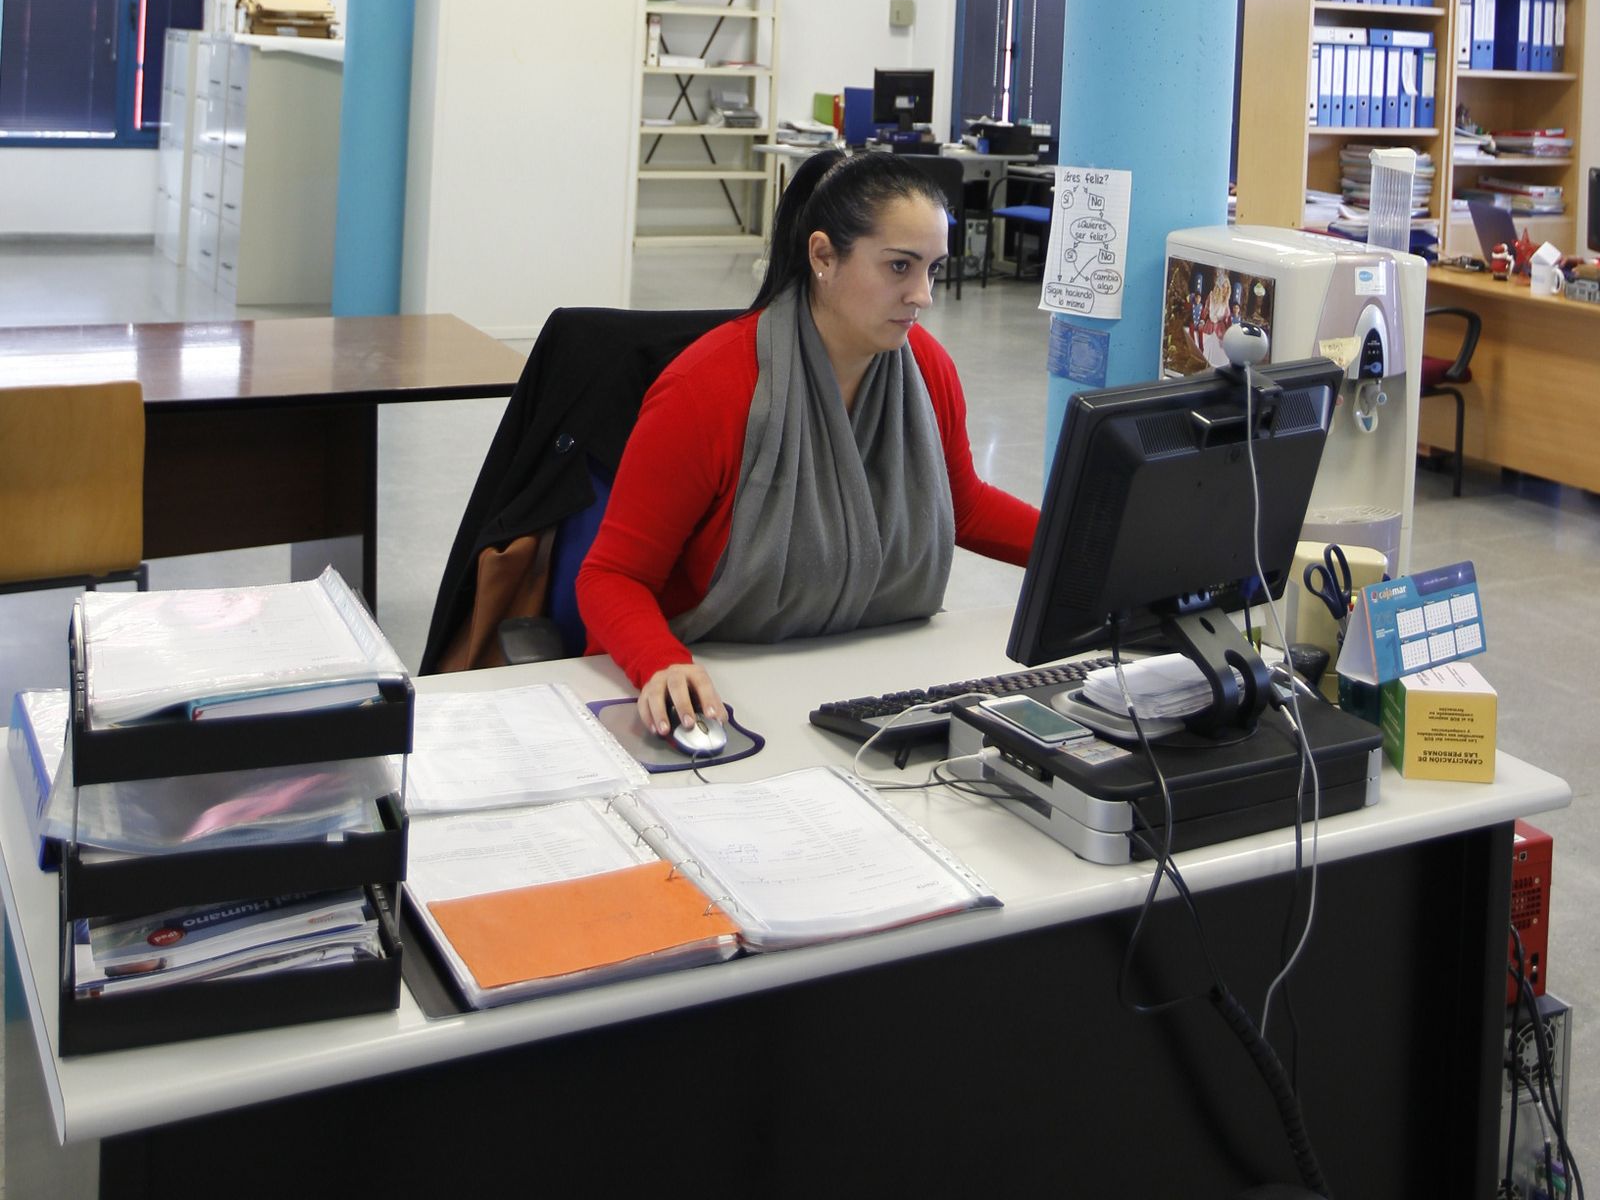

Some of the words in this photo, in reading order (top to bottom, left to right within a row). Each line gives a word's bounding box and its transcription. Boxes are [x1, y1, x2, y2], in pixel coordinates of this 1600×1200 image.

[1085, 173, 1109, 184] feliz?
[1077, 220, 1107, 230] ¿Quieres
[1090, 232, 1108, 241] feliz?
[1429, 757, 1483, 765] CAPACITACIÓN
[182, 900, 270, 927] Humano
